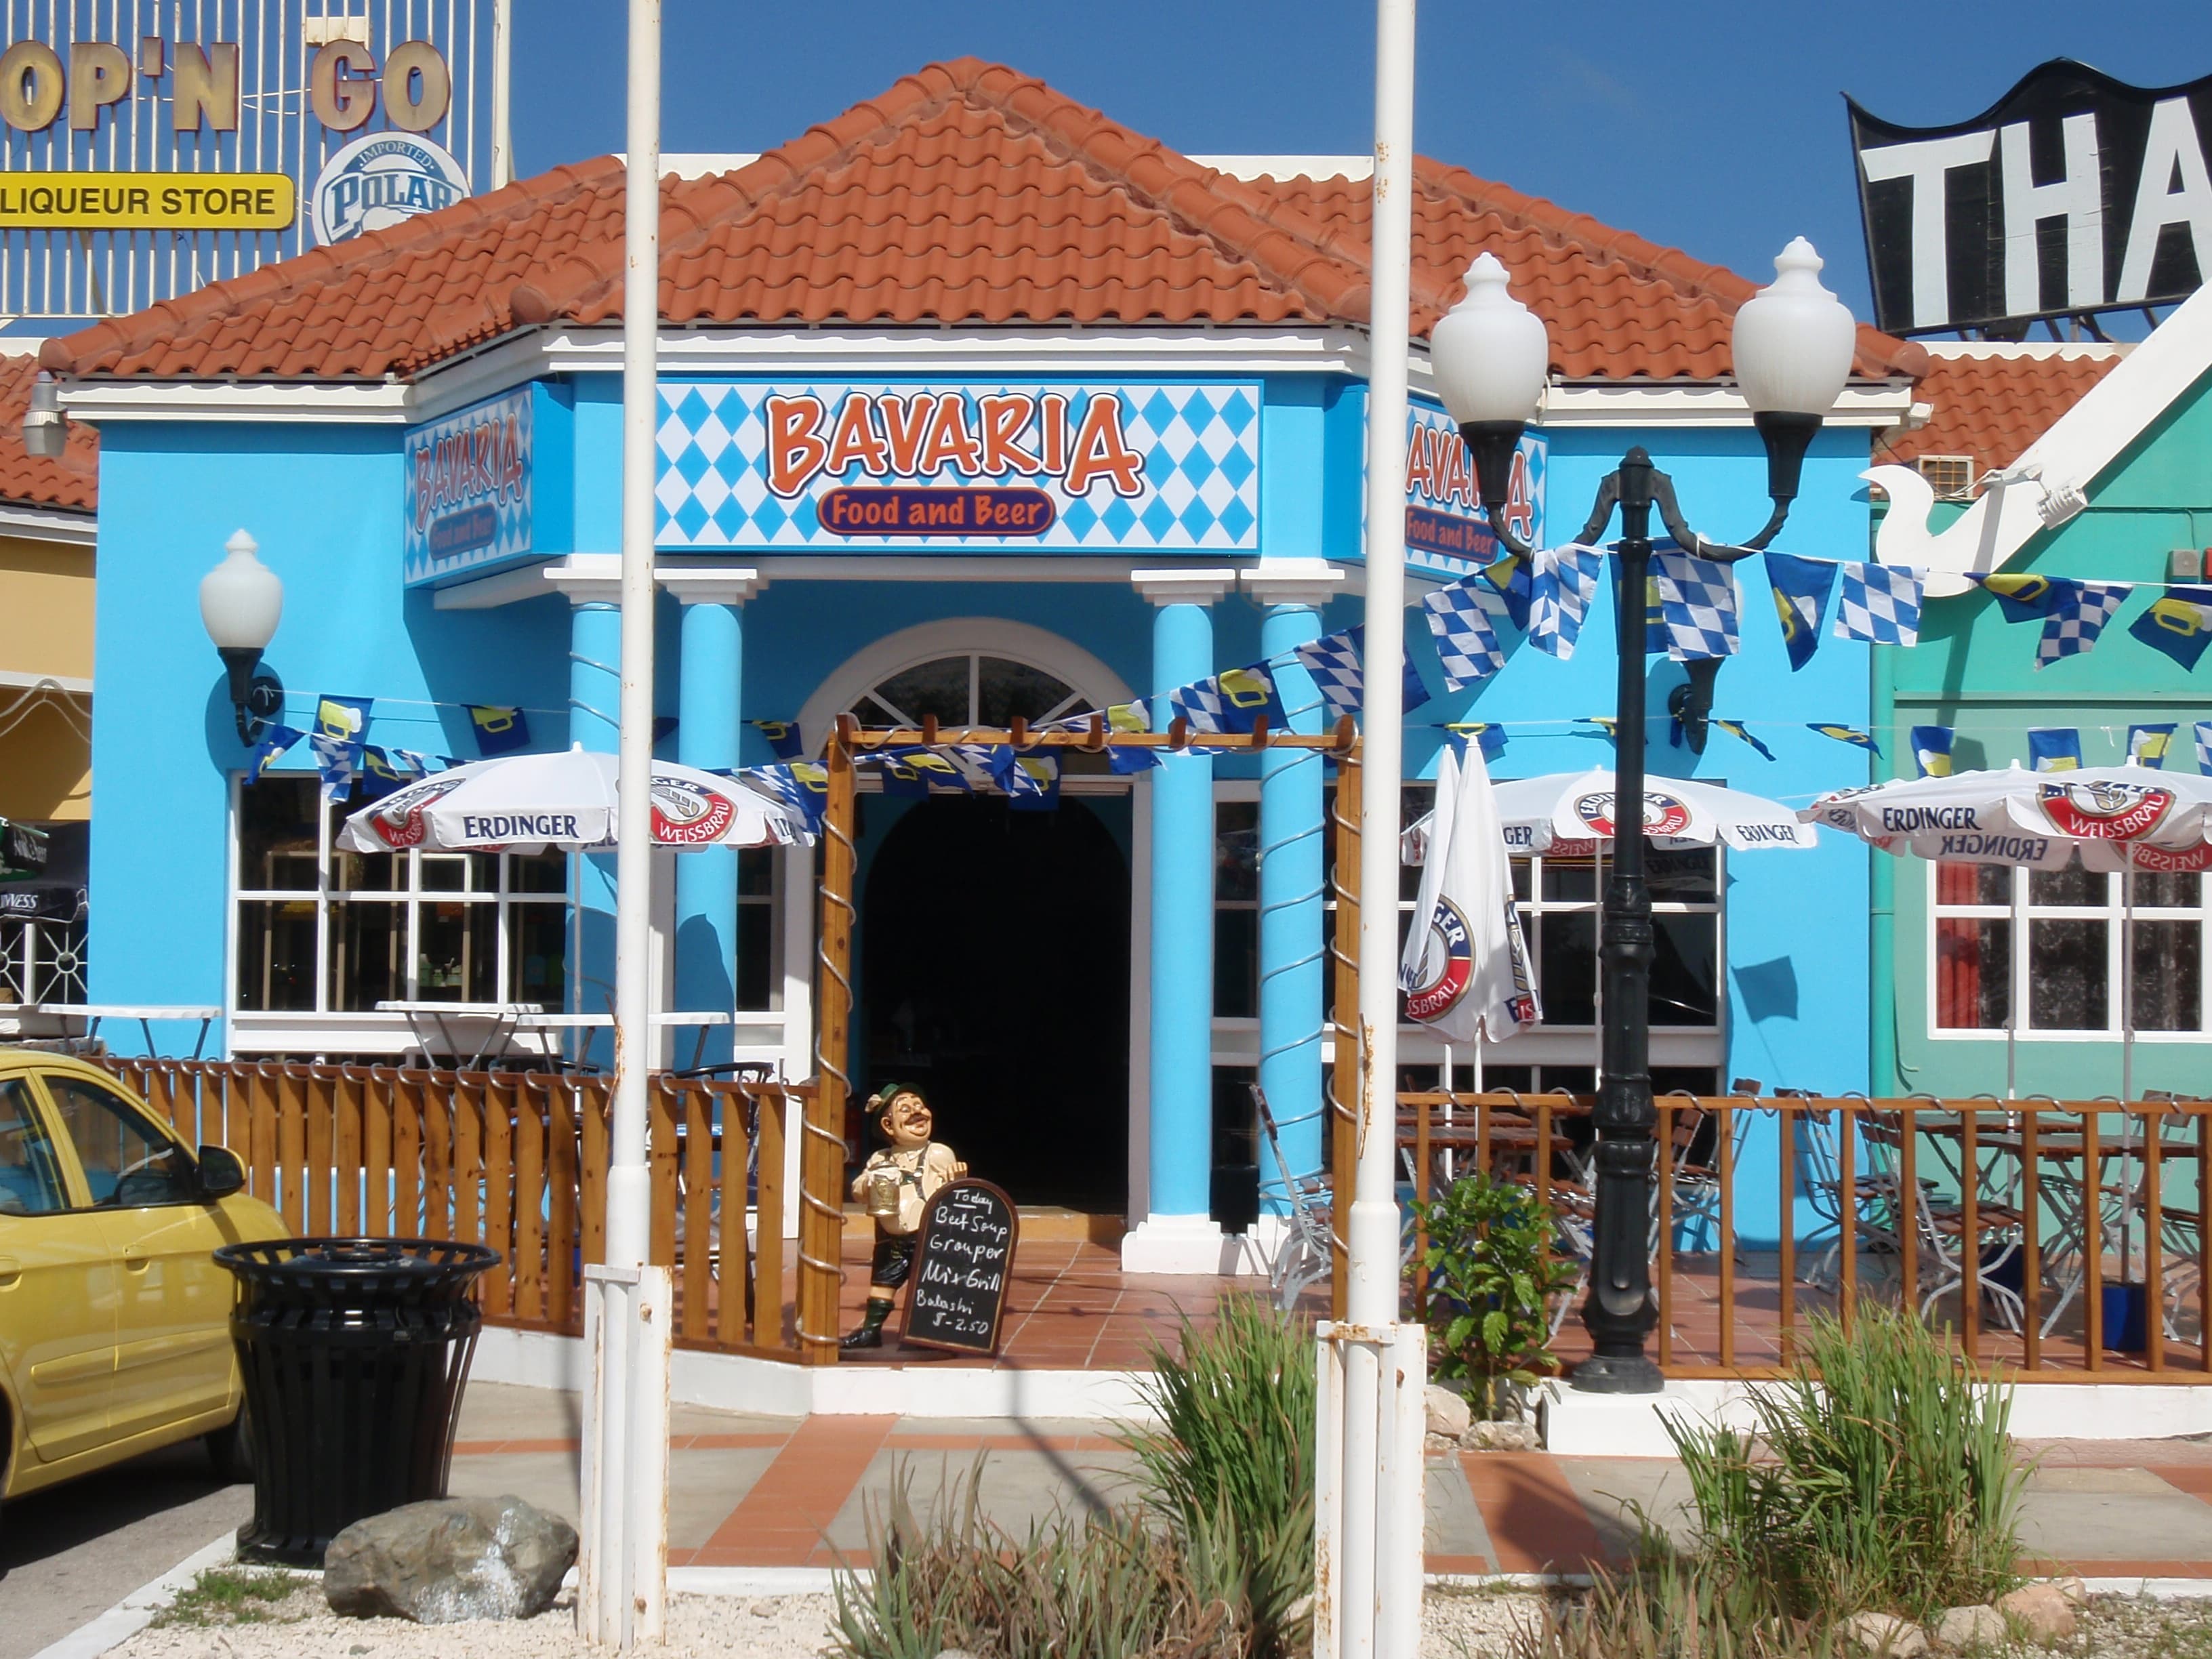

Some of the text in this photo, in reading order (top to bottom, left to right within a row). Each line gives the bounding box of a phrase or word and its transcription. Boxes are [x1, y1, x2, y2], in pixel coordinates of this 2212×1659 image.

[0, 37, 450, 132] OP'N GO
[359, 141, 432, 167] IMPORTED
[1, 188, 275, 215] LIQUEUR STORE
[331, 173, 452, 231] POLAR
[1860, 96, 2212, 328] THA
[766, 392, 1145, 499] BAVARIA
[415, 413, 523, 534] BAVARIA
[1405, 422, 1533, 540] AVAA
[832, 495, 1044, 525] Food and Beer
[1439, 524, 1462, 548] and
[462, 815, 580, 840] ERDINGER
[1883, 807, 1982, 833] ERDINGER
[952, 1189, 993, 1214] Today
[970, 1215, 1008, 1242] Soup
[930, 1234, 1004, 1263] Grouper
[966, 1269, 1000, 1292] Grill
